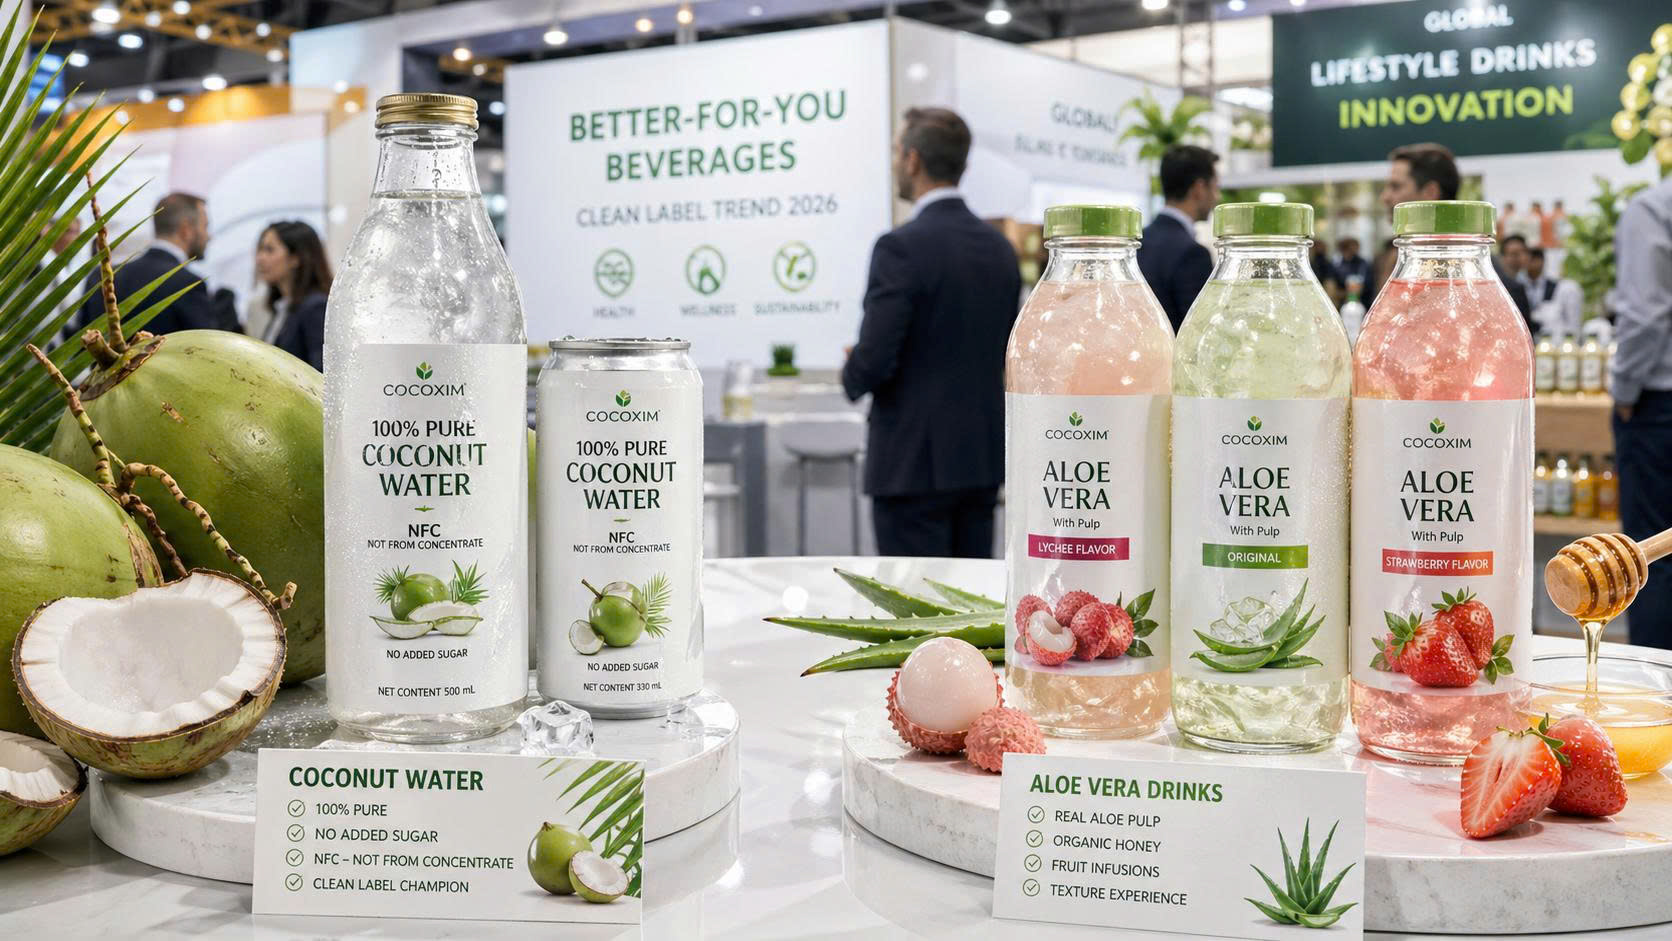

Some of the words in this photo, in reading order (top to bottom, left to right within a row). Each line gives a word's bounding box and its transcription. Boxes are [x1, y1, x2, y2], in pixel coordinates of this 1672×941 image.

[1424, 4, 1513, 32] GLOBAL
[1311, 50, 1459, 86] LIFESTYLE
[1470, 39, 1597, 74] DRINKS
[1339, 85, 1573, 128] INNOVATION
[570, 90, 846, 141] BETTER-FOR-YOU
[607, 140, 796, 181] BEVERAGES
[577, 205, 640, 227] CLEAN
[647, 202, 706, 223] LABEL
[715, 198, 781, 220] TREND
[789, 195, 838, 216] 2026
[594, 306, 634, 318] HEALTH
[681, 303, 736, 317] WELLNESS
[383, 384, 465, 397] COCOXIM
[586, 410, 659, 422] COCOXIM
[372, 420, 419, 437] 100%
[427, 420, 475, 436] PURE
[1045, 429, 1108, 440] COCOXIM
[1222, 435, 1287, 446] COCOXIM
[1403, 438, 1471, 449] COCOXIM
[362, 443, 487, 467] COCONUT
[576, 441, 618, 456] 100%
[625, 441, 667, 456] PURE
[567, 462, 676, 484] COCONUT
[1043, 461, 1111, 483] ALOE
[1219, 466, 1289, 489] ALOE
[379, 473, 471, 496] WATER
[1400, 470, 1474, 494] ALOE
[584, 489, 660, 510] WATER
[1043, 487, 1111, 510] VERA
[1219, 494, 1290, 518] VERA
[1400, 498, 1474, 523] VERA
[408, 524, 440, 537] NFC
[1053, 517, 1074, 529] With
[1078, 518, 1100, 531] Pulp
[609, 532, 635, 543] NFC
[1230, 525, 1253, 536] With
[1257, 526, 1280, 539] Pulp
[1411, 531, 1435, 542] With
[1439, 531, 1463, 545] Pulp
[368, 539, 385, 548] NOT
[389, 539, 415, 549] FROM
[418, 538, 483, 549] CONCENTRATE
[591, 545, 613, 553] FROM
[616, 544, 670, 554] CONCENTRATE
[1038, 543, 1071, 555] LYCHEE
[1074, 543, 1115, 555] FLAVOR
[1228, 552, 1281, 564] ORIGINAL
[1386, 556, 1449, 570] STRAWBERRY
[1452, 557, 1488, 570] FLAVOR
[387, 650, 400, 659] NO
[403, 649, 435, 659] ADDED
[438, 649, 468, 658] SUGAR
[588, 662, 599, 671] NO
[602, 662, 630, 671] ADDED
[633, 662, 658, 670] SUGAR
[378, 687, 395, 696] NET
[397, 687, 441, 697] CONTENT
[444, 687, 460, 696] 500
[463, 685, 475, 695] mL
[583, 683, 597, 691] NET
[599, 683, 635, 692] CONTENT
[637, 683, 649, 691] 330
[289, 767, 399, 789] COCONUT
[406, 770, 483, 791] WATER
[1030, 774, 1082, 795] ALOE
[1088, 777, 1141, 798] VERA
[1148, 780, 1223, 802] DRINKS
[315, 803, 349, 816] 100%
[354, 804, 387, 817] PURE
[1055, 810, 1087, 823] REAL
[1089, 812, 1124, 825] ALOE
[1128, 814, 1161, 828] PULP
[315, 828, 336, 840] NO
[341, 829, 388, 841] ADDED
[393, 830, 438, 842] SUGAR
[1053, 835, 1111, 849] ORGANIC
[1115, 838, 1161, 852] HONEY
[314, 853, 339, 865] NFC
[353, 854, 380, 866] NOT
[383, 855, 419, 867] FROM
[422, 855, 513, 869] CONCENTRATE
[1052, 859, 1087, 873] FRUIT
[1091, 861, 1160, 878] INFUSIONS
[313, 878, 355, 891] CLEAN
[358, 879, 396, 891] LABEL
[399, 880, 469, 893] CHAMPION
[1051, 884, 1105, 899] TEXTURE
[1109, 888, 1187, 906] EXPERIENCE
